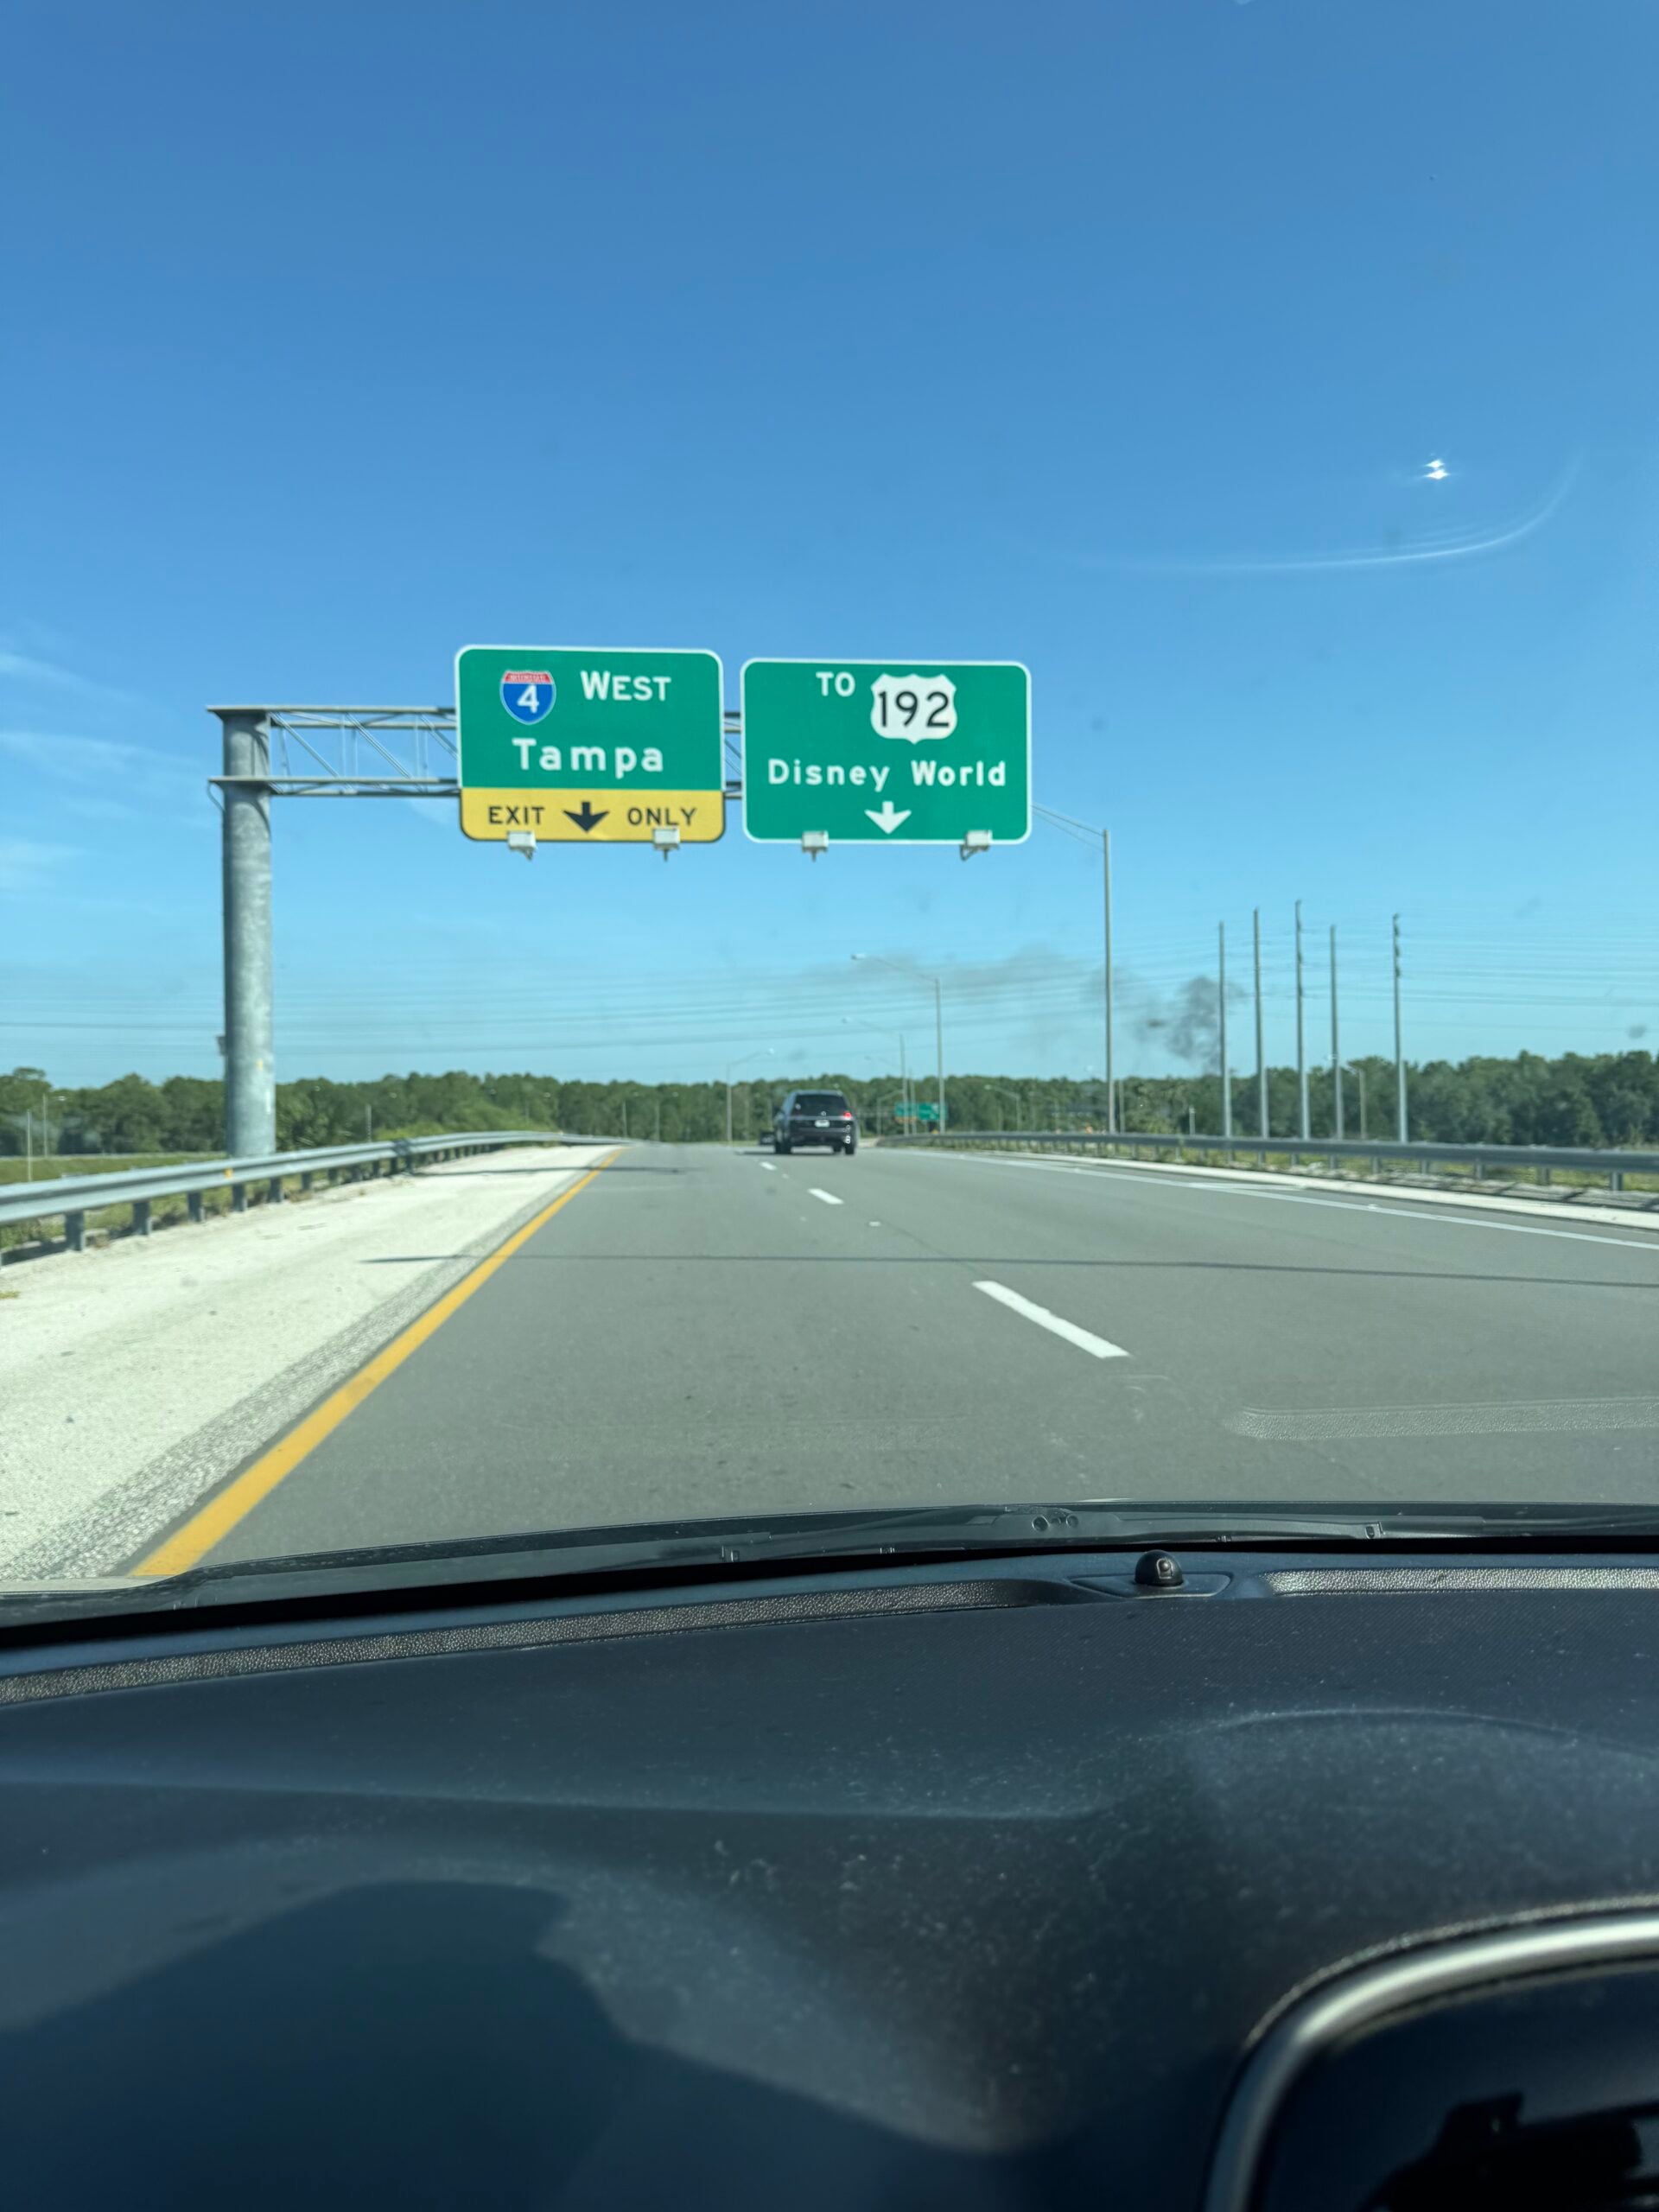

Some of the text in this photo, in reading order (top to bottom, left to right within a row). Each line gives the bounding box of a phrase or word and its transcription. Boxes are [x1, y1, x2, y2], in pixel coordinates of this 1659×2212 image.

[517, 670, 671, 714] 4 WEST
[815, 671, 950, 728] TO 192
[512, 737, 664, 779] Tampa
[767, 758, 1007, 793] Disney World
[487, 805, 697, 826] EXIT ONLY
